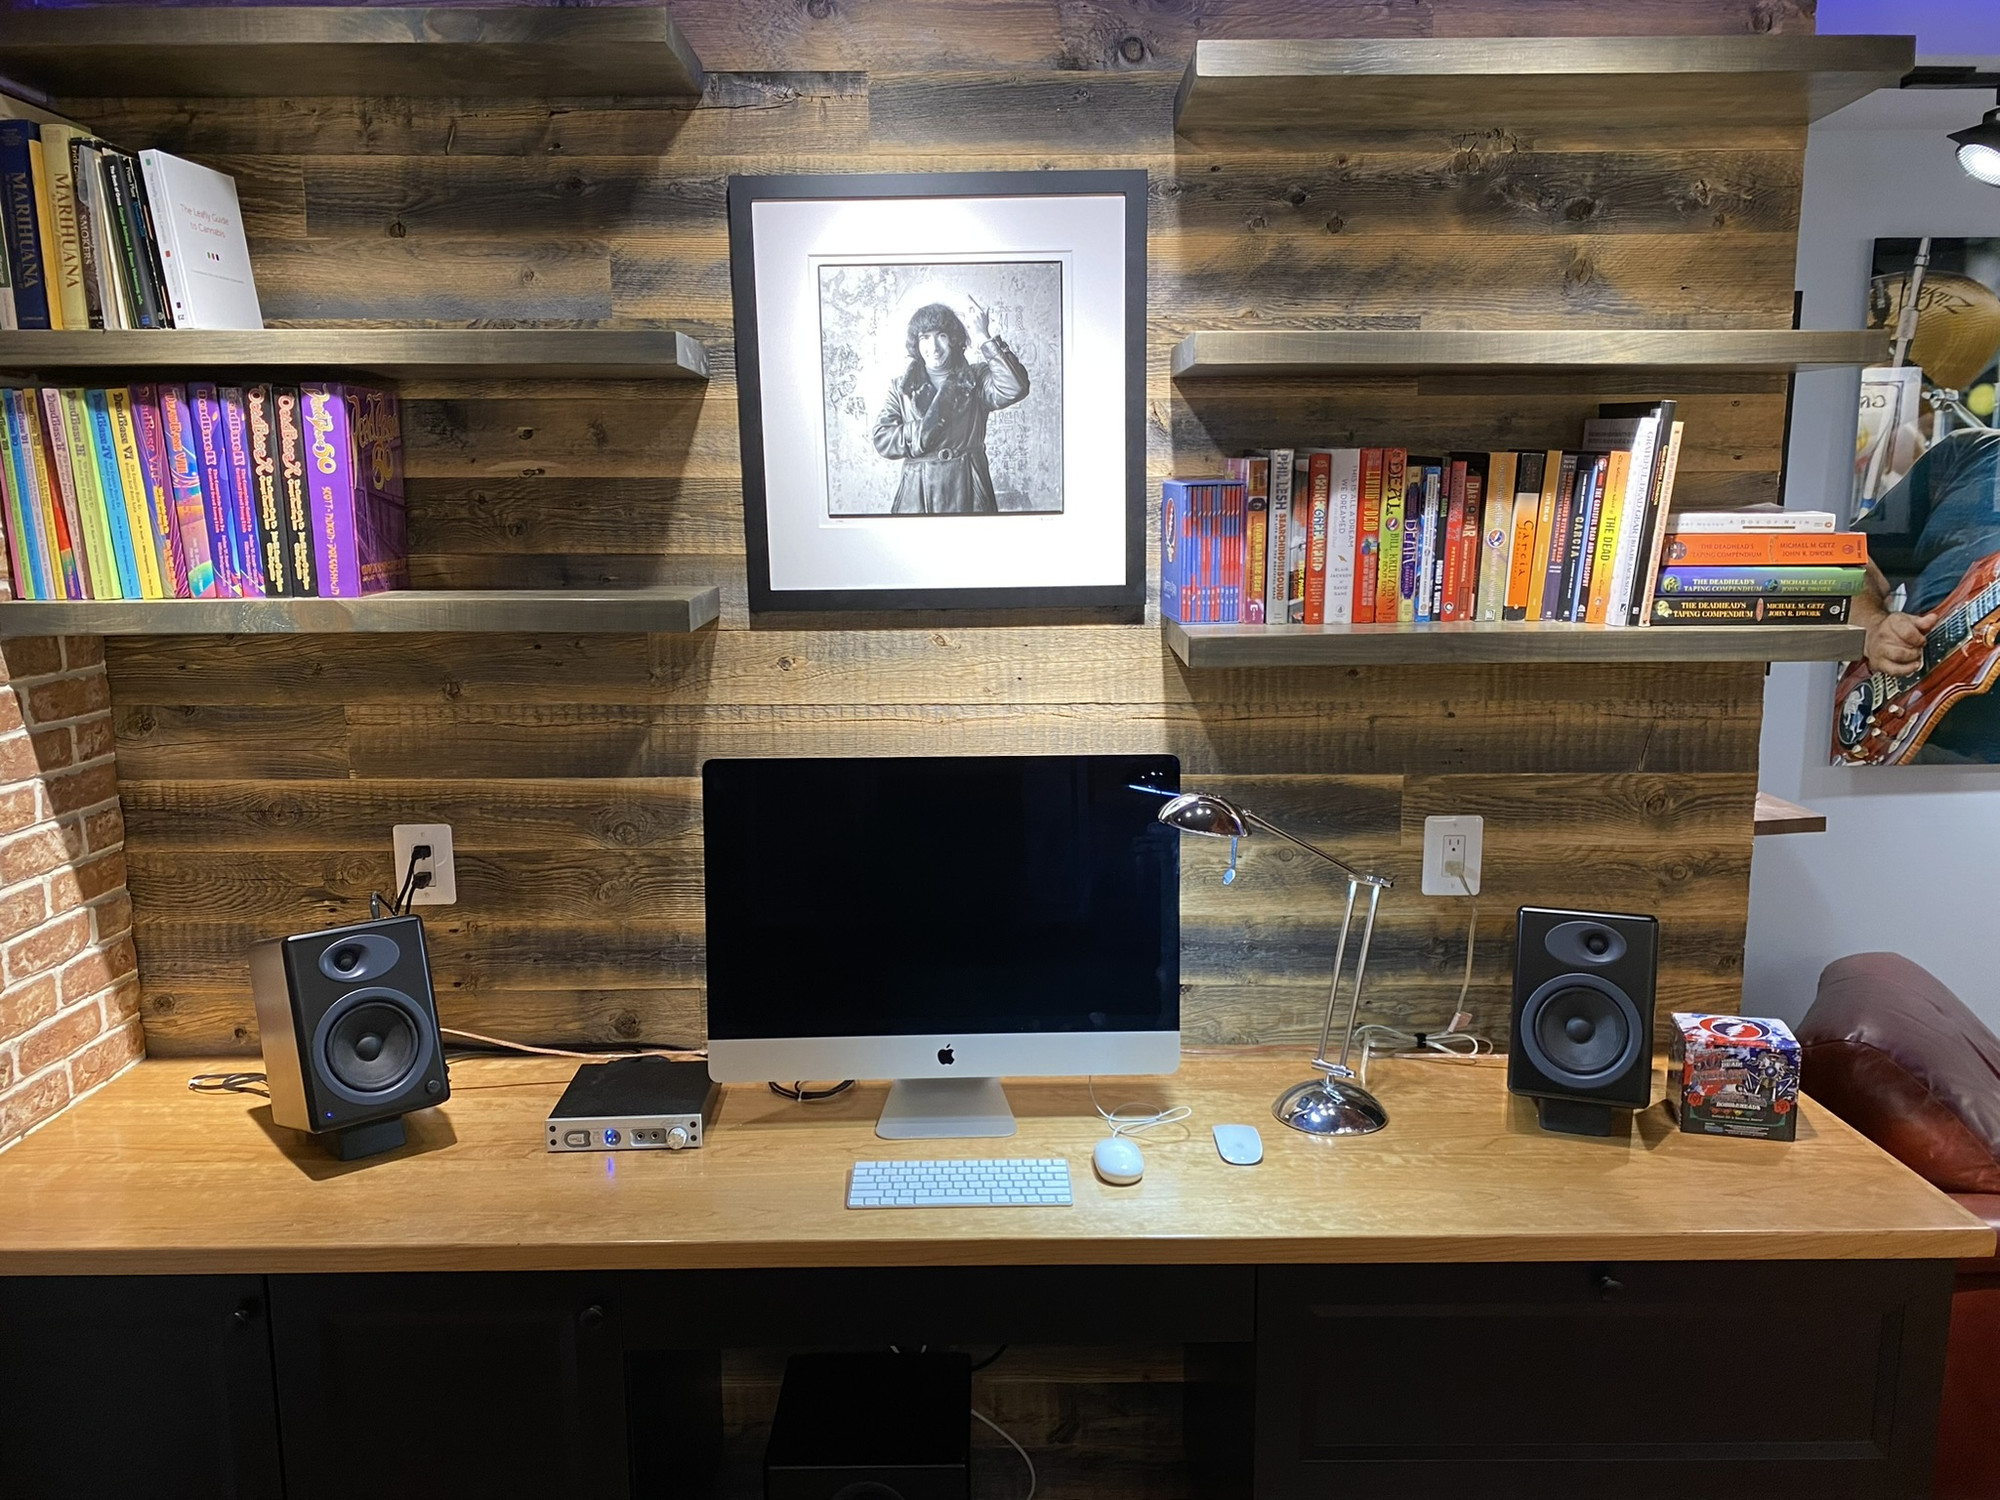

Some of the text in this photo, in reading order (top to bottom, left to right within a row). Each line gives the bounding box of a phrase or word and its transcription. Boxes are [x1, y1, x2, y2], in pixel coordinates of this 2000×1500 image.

[11, 172, 38, 288] MARIHUANA
[54, 173, 80, 288] MARIHUANA
[79, 214, 92, 265] SMOKERS
[180, 203, 230, 226] The Leafly Guide
[198, 224, 226, 238] Cannabis
[46, 394, 62, 442] DeadBase
[66, 390, 82, 442] DeadBase
[93, 394, 108, 444] DeadBase
[114, 392, 128, 444] DeadBase
[312, 444, 336, 474] 50
[1274, 454, 1289, 510] PHIL LESH
[1338, 479, 1348, 534] WE DREAMED
[1364, 470, 1380, 532] LIVING DEAD
[1386, 460, 1402, 516] DEAL
[1466, 482, 1479, 504] DARK
[1313, 509, 1326, 536] THEE
[1462, 516, 1476, 537] STAR
[1570, 516, 1584, 558] GARCIA
[1582, 488, 1602, 588] THE GRATEFUL DEAD AND PHILOSOPHY
[1600, 516, 1616, 562] THE DEAD
[1624, 432, 1654, 596] GRATEFUL DEAD GEAR BLAIR JACKSON
[1276, 514, 1287, 600] SEARCHING SOUND
[1403, 519, 1418, 564] BEAR
[1516, 520, 1534, 576] Garcia
[1556, 547, 1564, 563] DEAD
[1387, 533, 1400, 610] BILL KREUTZMANN
[1436, 560, 1444, 584] HOWARD
[1433, 592, 1441, 614] WEINER
[1674, 610, 1753, 618] TAPING COMPENDIUM
